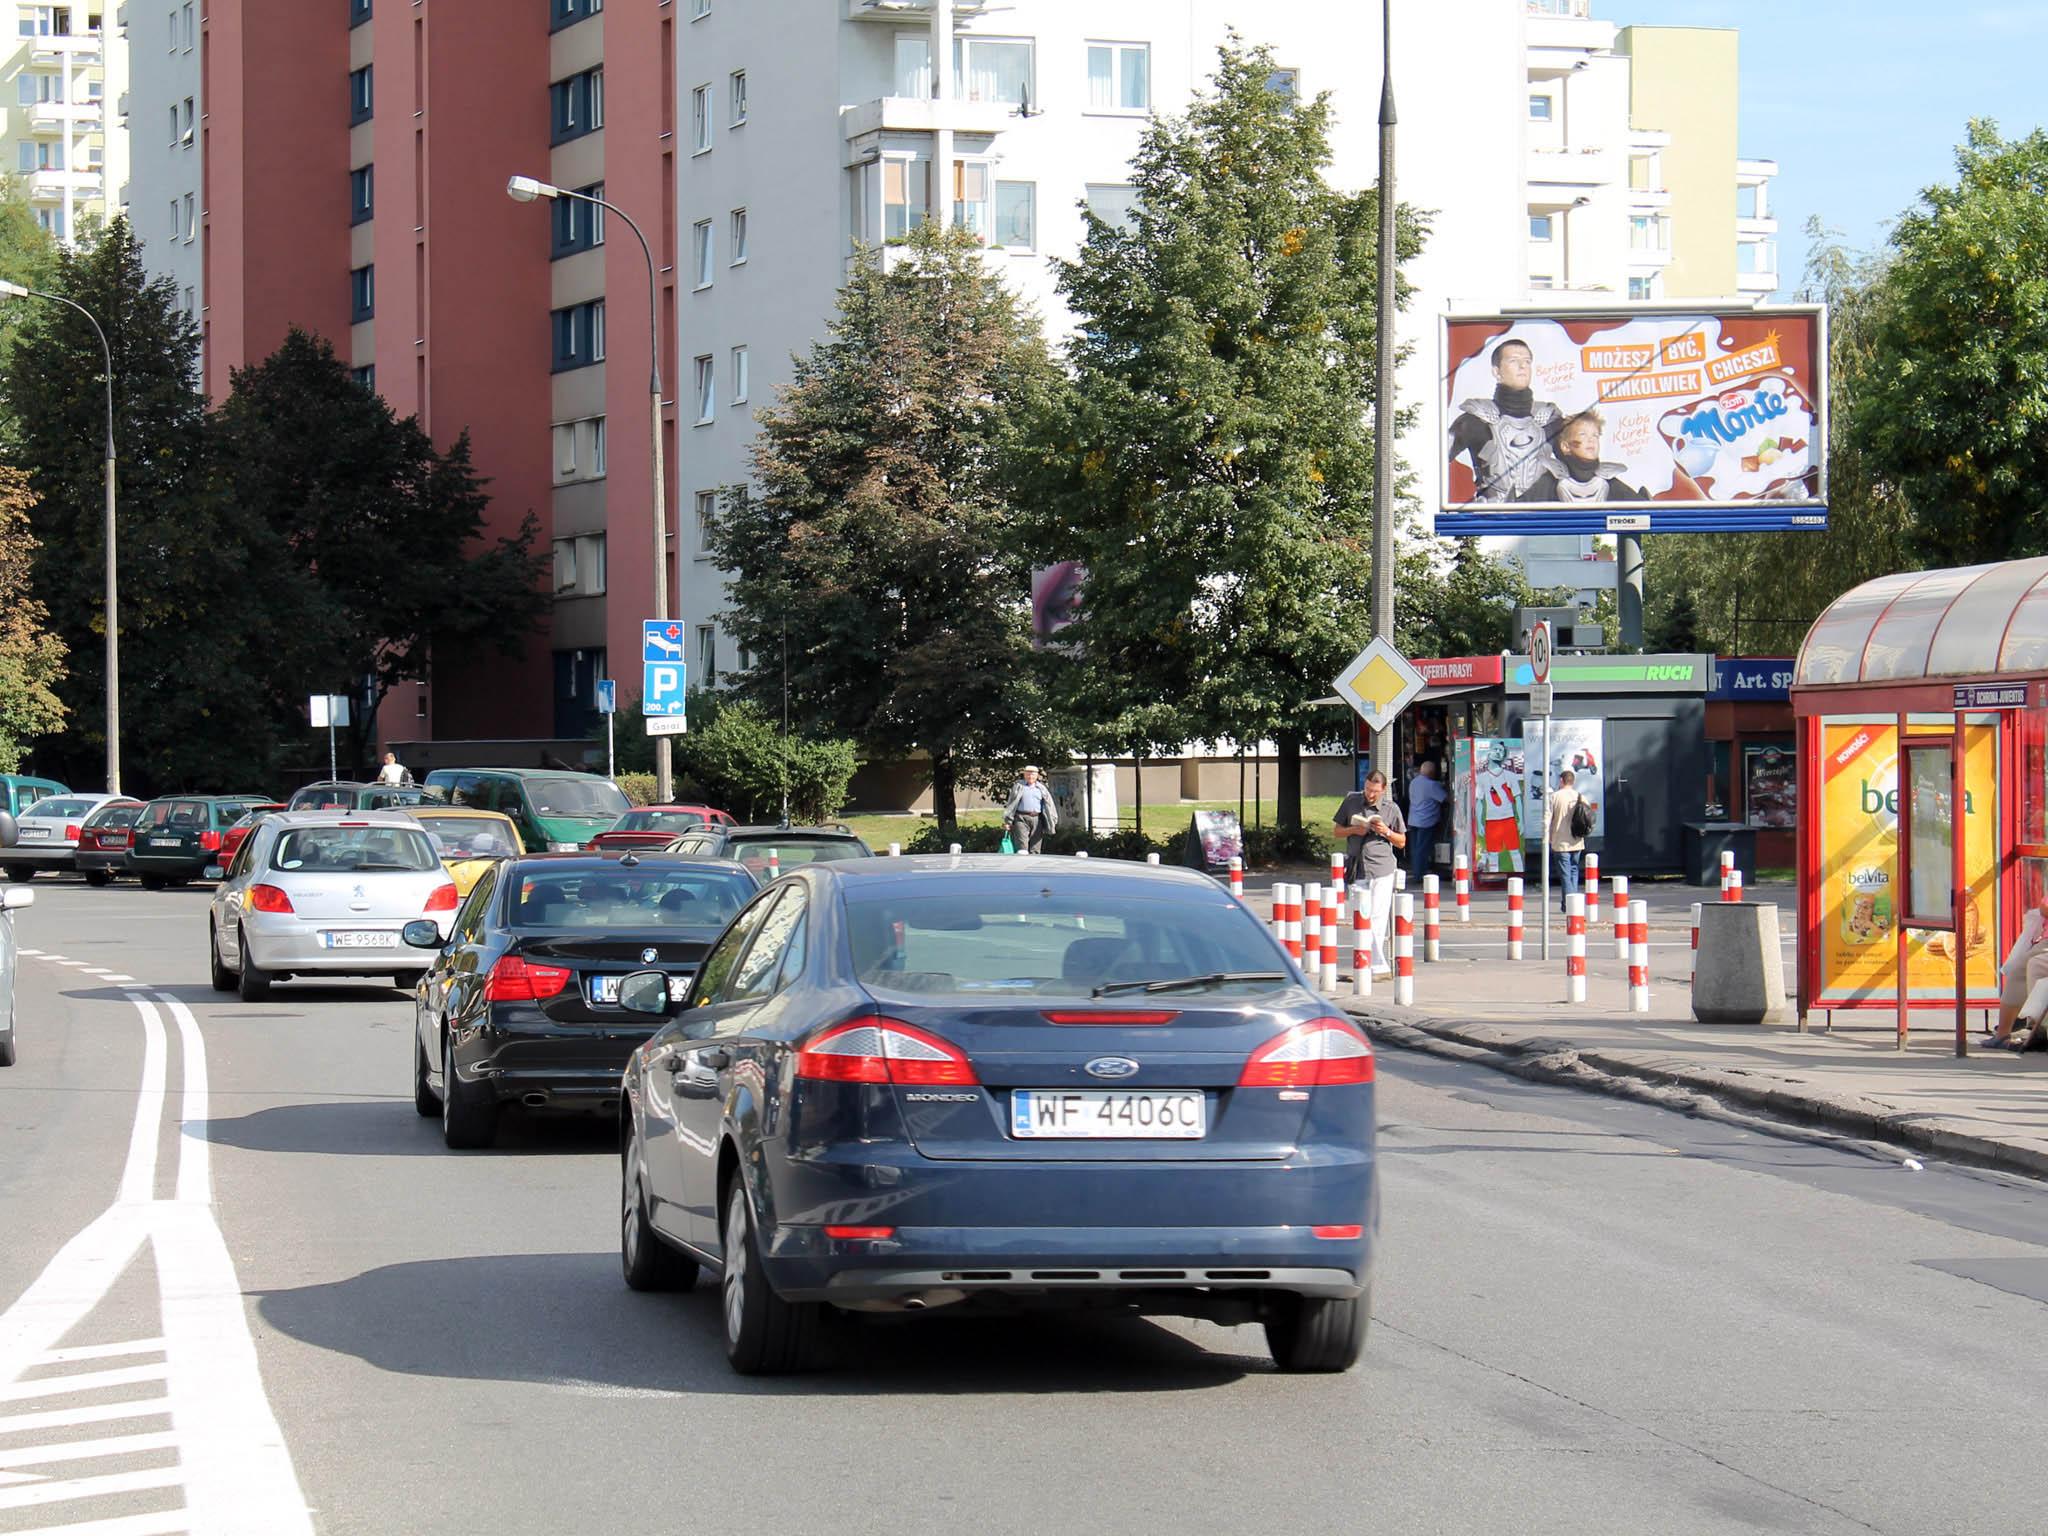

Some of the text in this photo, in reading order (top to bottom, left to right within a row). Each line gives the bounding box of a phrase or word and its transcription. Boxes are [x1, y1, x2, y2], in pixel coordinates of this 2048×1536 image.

[1589, 336, 1702, 369] MOŻESZ BYĆ,
[1602, 347, 1776, 398] KIMKOLWIEK CHCESZ!
[1619, 412, 1651, 428] Kuba
[1681, 391, 1788, 446] Monte
[1612, 425, 1650, 444] Kurek
[1423, 664, 1448, 679] OFERTA
[1449, 663, 1473, 678] PRASY!
[1647, 665, 1693, 681] RUCH
[654, 668, 677, 700] P
[1734, 672, 1767, 689] Art.
[1999, 689, 2025, 704] JUVENTUS
[1848, 869, 1889, 884] belVita
[335, 934, 393, 946] WE 9568K
[906, 1093, 979, 1102] MONDEO
[1037, 1095, 1196, 1126] WF 4406C
